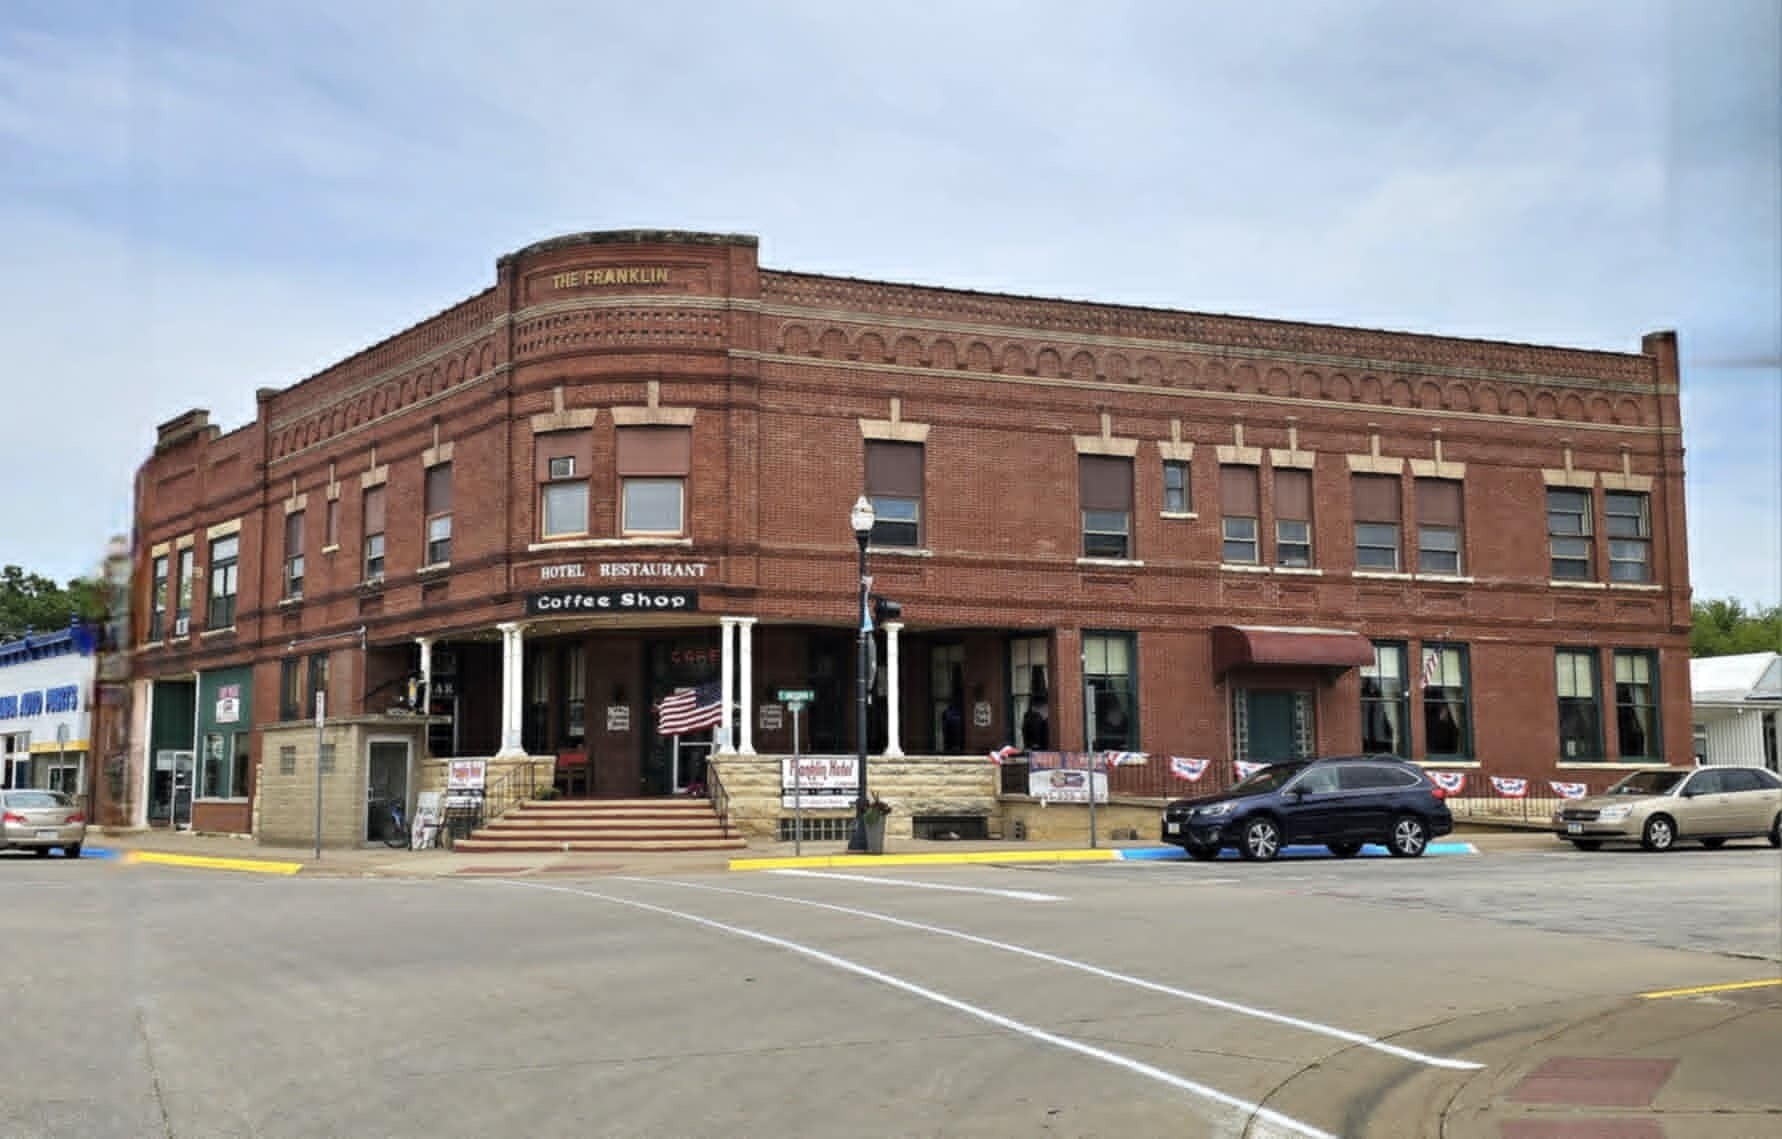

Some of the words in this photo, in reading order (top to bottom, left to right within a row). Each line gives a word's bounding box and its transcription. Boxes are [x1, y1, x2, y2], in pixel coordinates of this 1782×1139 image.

[552, 271, 580, 289] THE
[584, 267, 669, 286] FRANKLIN
[541, 564, 585, 580] HOTEL
[600, 562, 708, 577] RESTAURANT
[537, 594, 611, 609] Coffee
[620, 592, 686, 608] Shop
